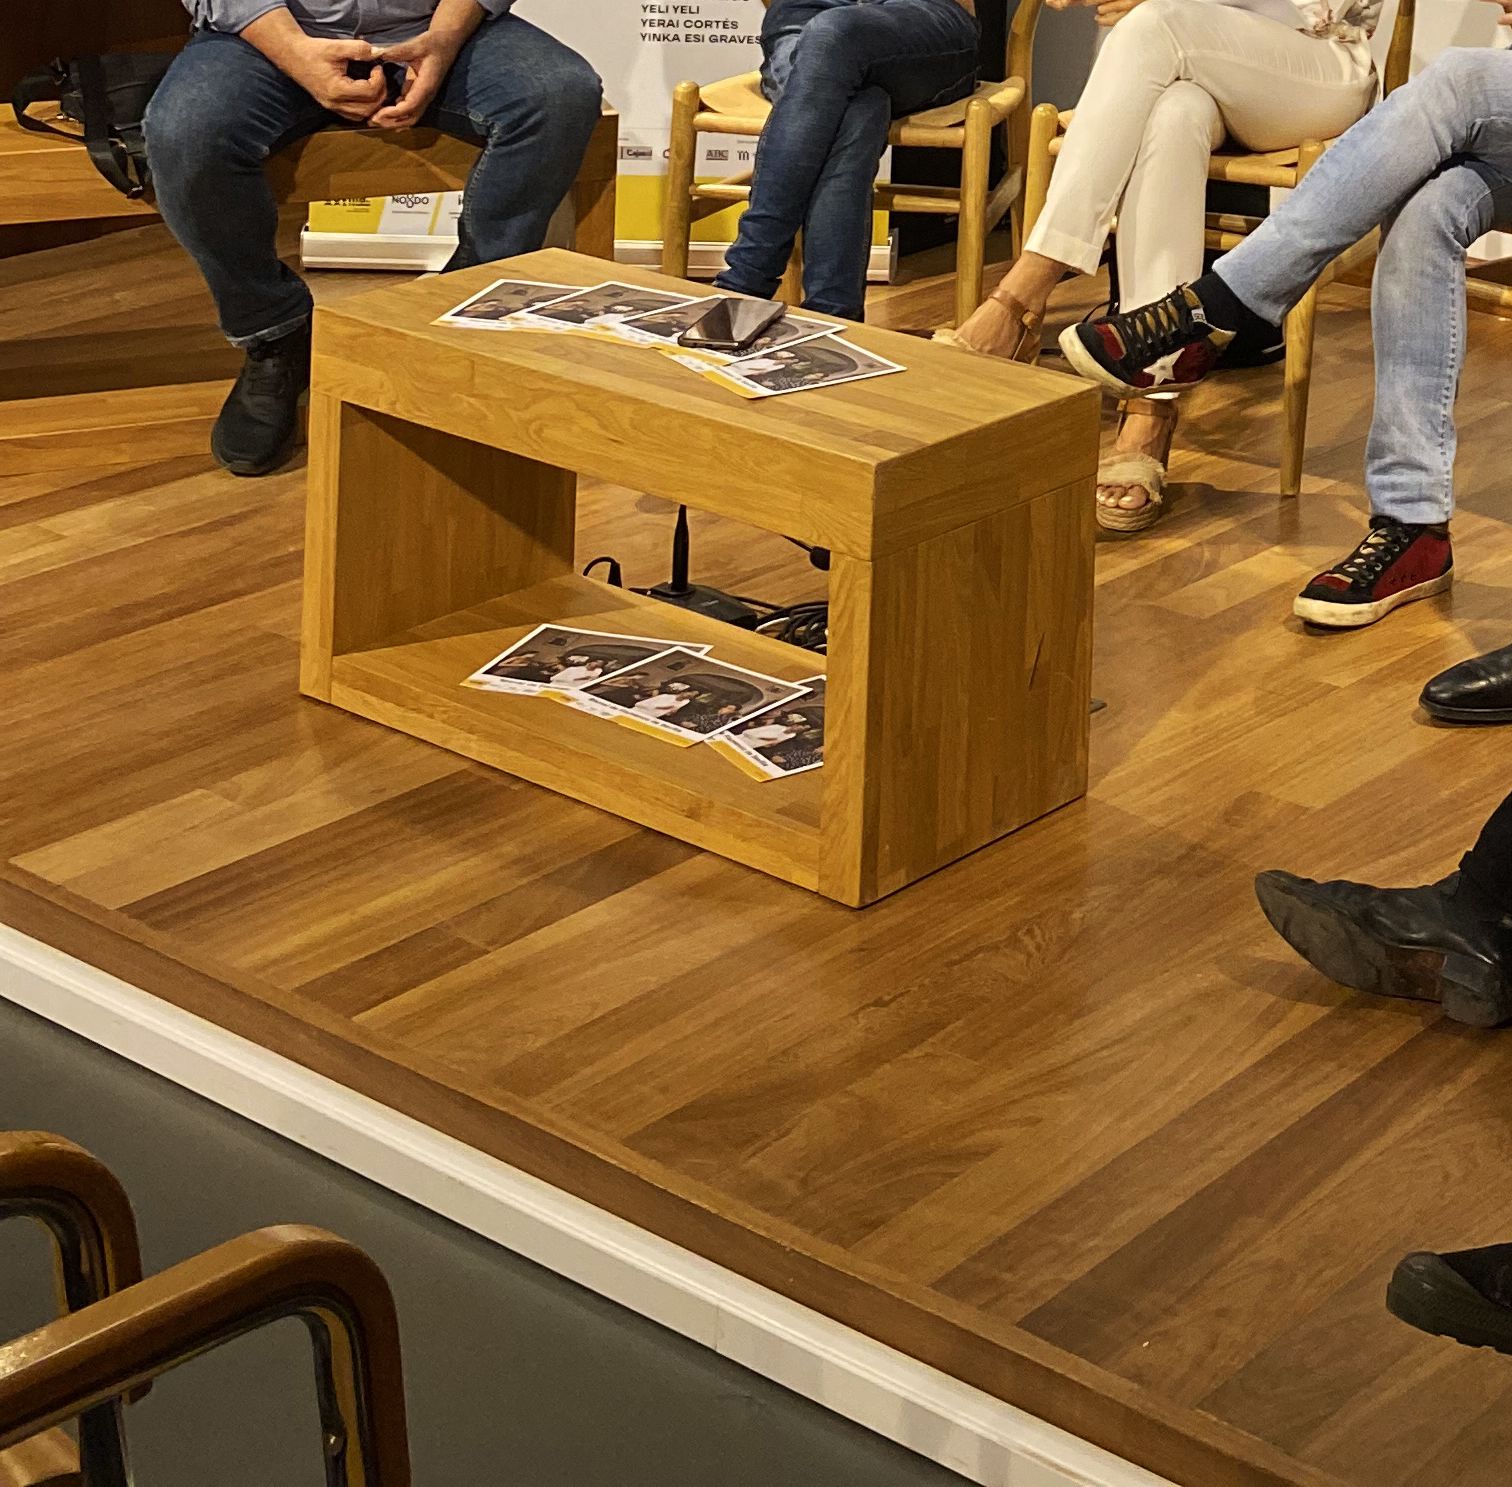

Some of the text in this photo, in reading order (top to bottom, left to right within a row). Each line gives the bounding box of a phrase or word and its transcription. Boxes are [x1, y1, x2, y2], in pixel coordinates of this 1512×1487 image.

[641, 5, 700, 14] YELI YELI
[640, 18, 738, 30] YERAI CORTÉS
[640, 32, 763, 45] YINKA ESI GRAVES
